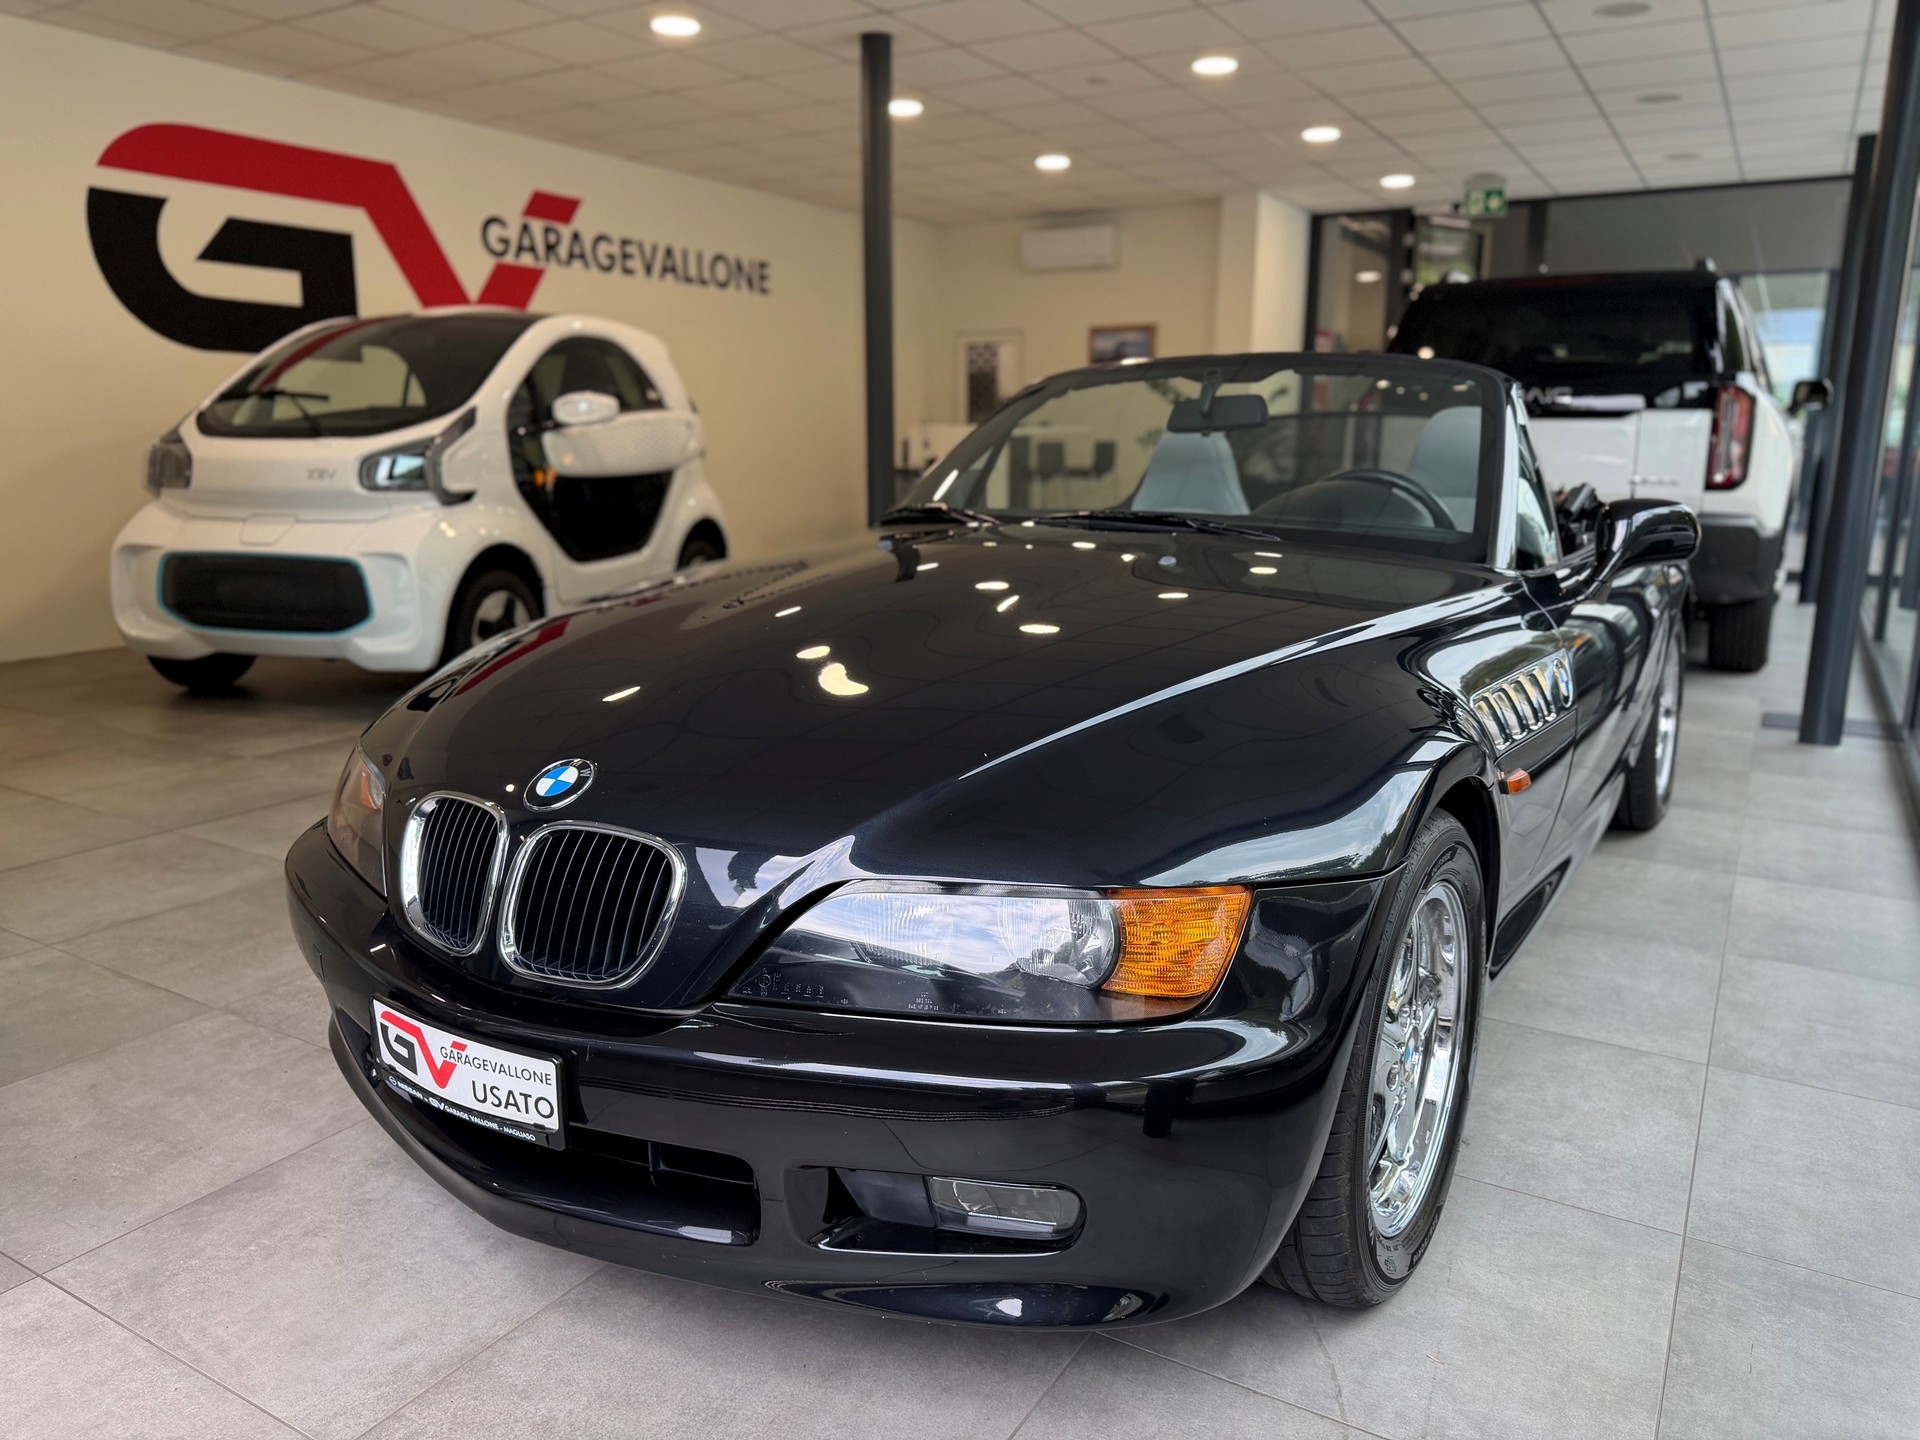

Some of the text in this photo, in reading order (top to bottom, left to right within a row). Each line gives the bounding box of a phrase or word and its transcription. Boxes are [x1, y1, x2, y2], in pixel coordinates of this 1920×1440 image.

[481, 216, 771, 295] GARAGEVALLONE
[380, 1011, 467, 1089] GV
[440, 1046, 552, 1086] GARAGEVALLONE
[471, 1080, 555, 1119] USATO
